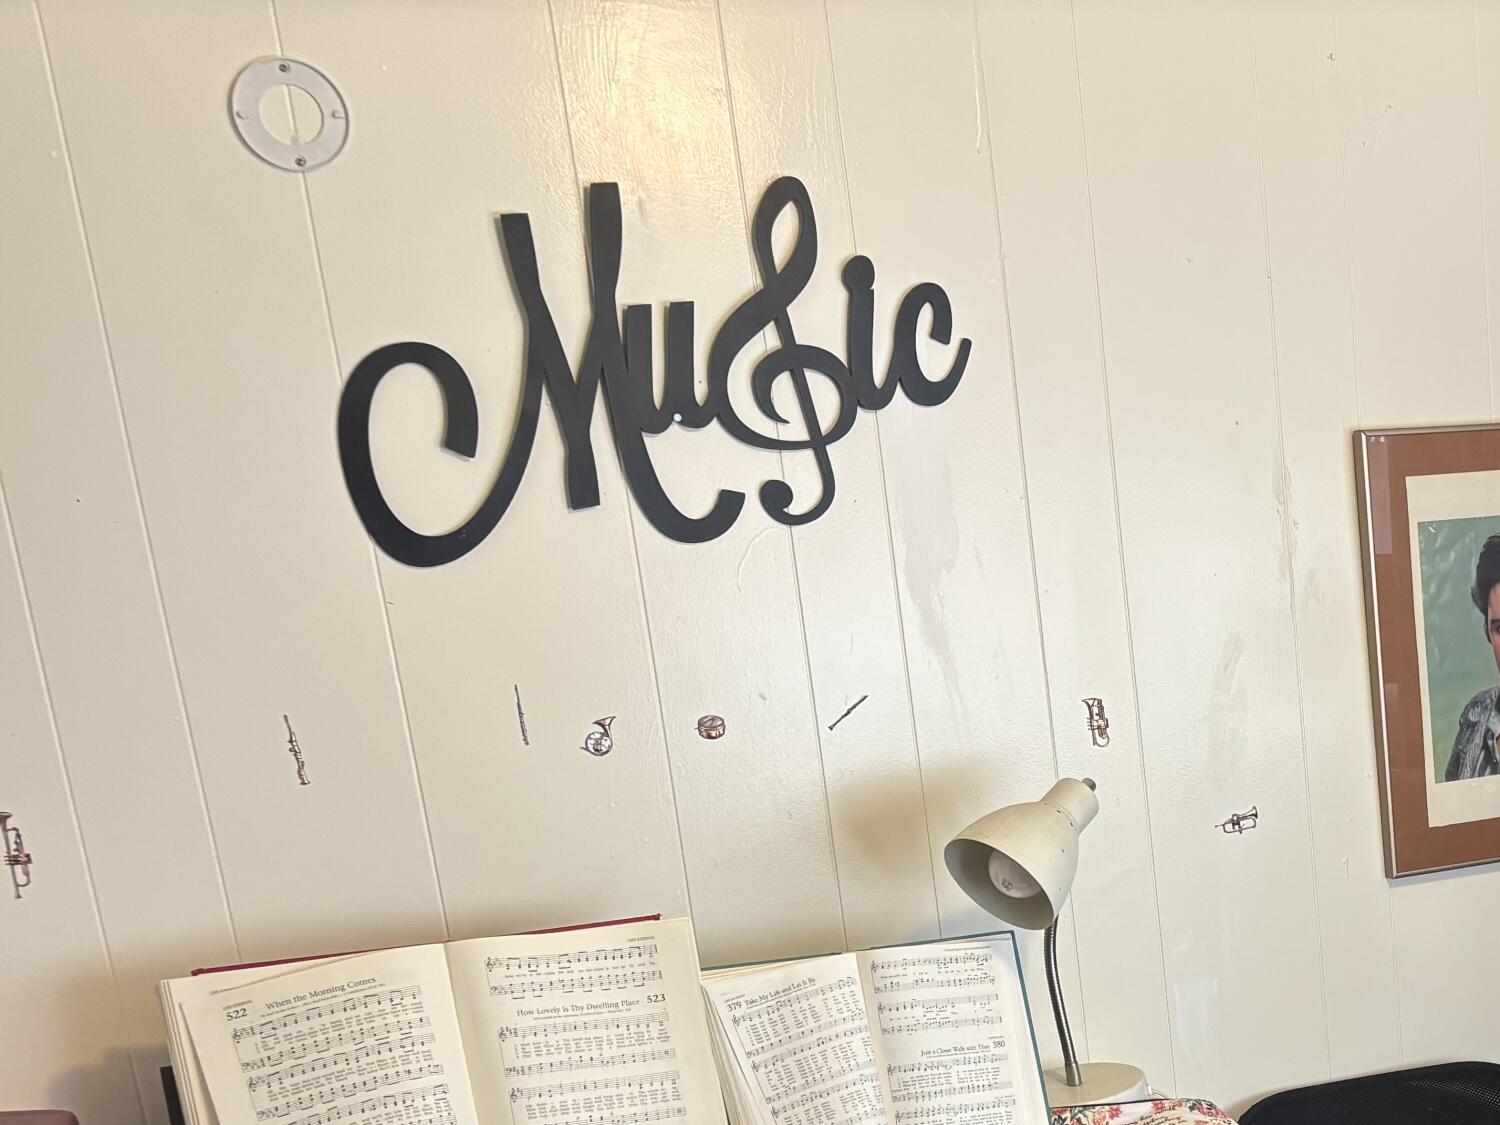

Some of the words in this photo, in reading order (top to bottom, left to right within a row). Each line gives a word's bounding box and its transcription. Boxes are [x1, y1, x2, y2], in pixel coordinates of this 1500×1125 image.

[340, 176, 972, 568] Music
[265, 996, 292, 1010] When
[293, 992, 308, 1003] the
[308, 983, 347, 1001] Morning
[347, 975, 377, 990] Comes
[646, 993, 666, 1004] 523
[744, 997, 759, 1006] Take
[758, 993, 770, 1003] My
[769, 989, 782, 999] Life
[781, 985, 792, 994] and
[791, 981, 802, 991] Let
[807, 976, 816, 985] Be
[225, 1007, 249, 1021] 522
[517, 1009, 535, 1017] How
[536, 1006, 561, 1017] Lovely
[571, 1004, 585, 1013] Thy
[586, 1000, 619, 1012] Dwelling
[621, 998, 640, 1007] Place
[726, 1001, 743, 1012] 379
[920, 1048, 931, 1057] Just
[935, 1046, 952, 1054] Closer
[952, 1044, 965, 1053] Walk
[966, 1043, 978, 1051] with
[978, 1042, 990, 1050] Thee
[992, 1040, 1006, 1049] 380
